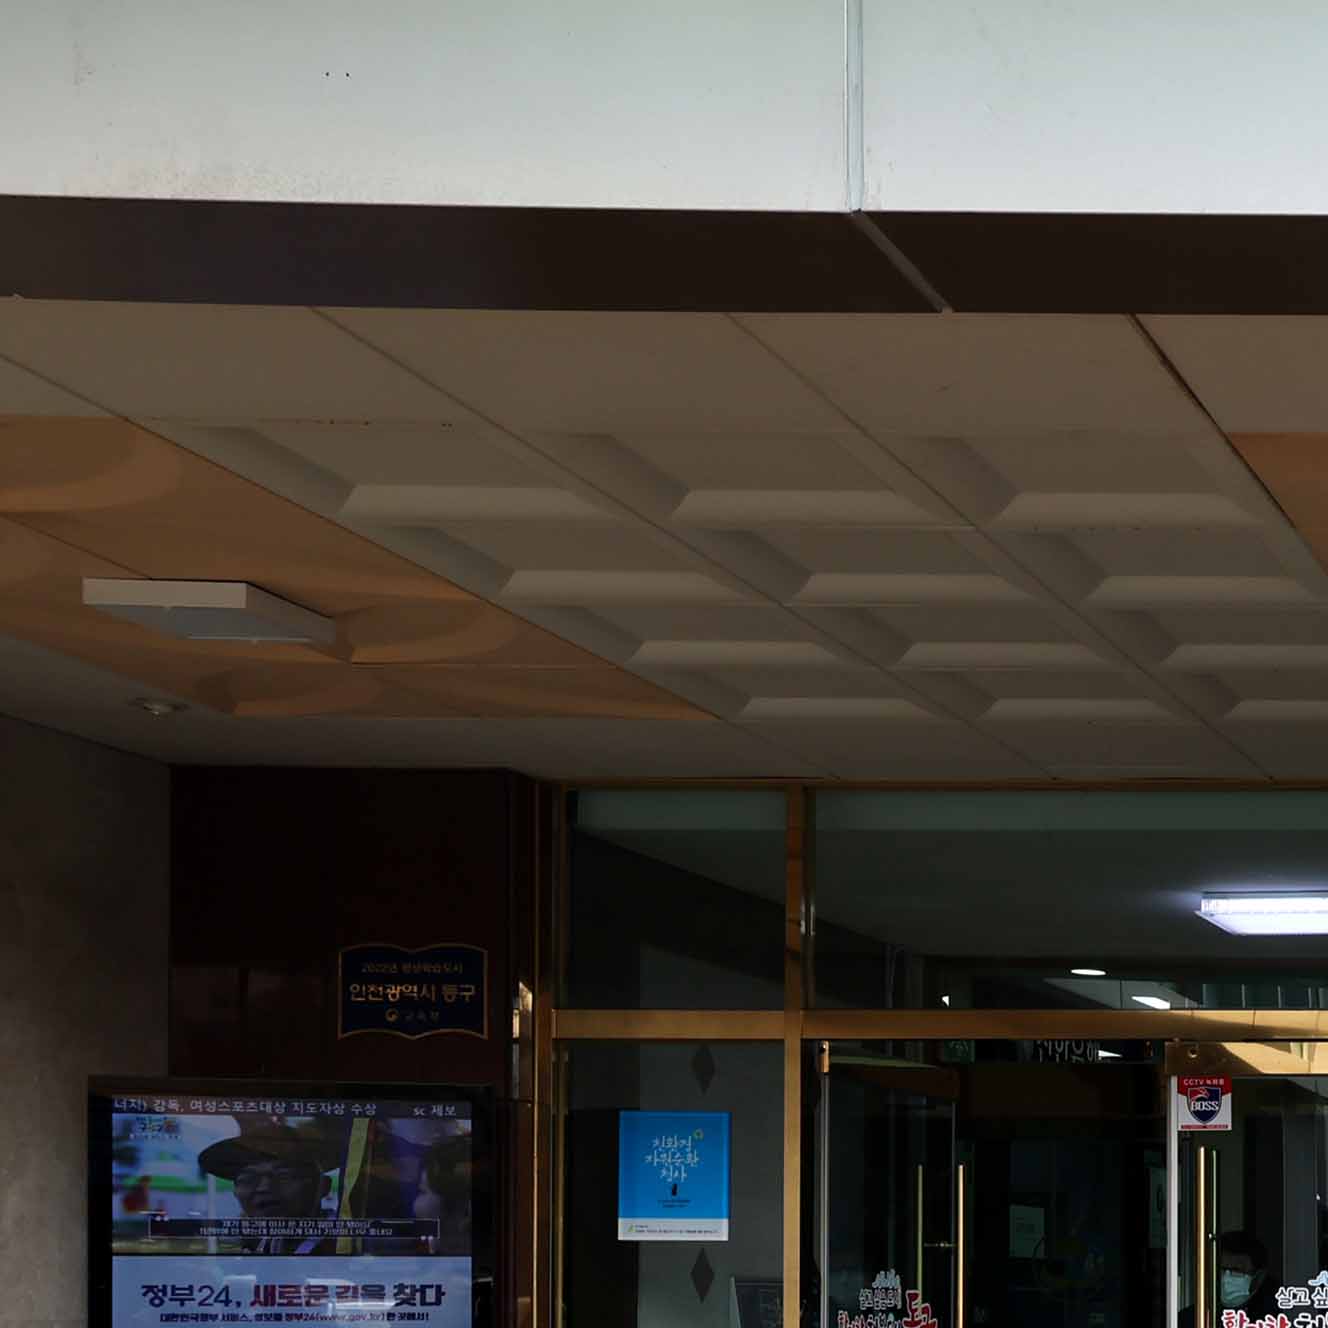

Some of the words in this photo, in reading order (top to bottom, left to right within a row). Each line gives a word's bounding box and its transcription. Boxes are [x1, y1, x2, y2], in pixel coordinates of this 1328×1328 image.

[190, 1100, 287, 1114] 여성스포츠대상
[292, 1102, 345, 1116] 지도자상
[351, 1102, 377, 1116] 수상
[1191, 1100, 1219, 1112] BOSS
[141, 1283, 242, 1308] 정부24,
[250, 1283, 329, 1308] 새로운
[393, 1283, 446, 1307] 찾다
[1276, 1287, 1311, 1309] 살고
